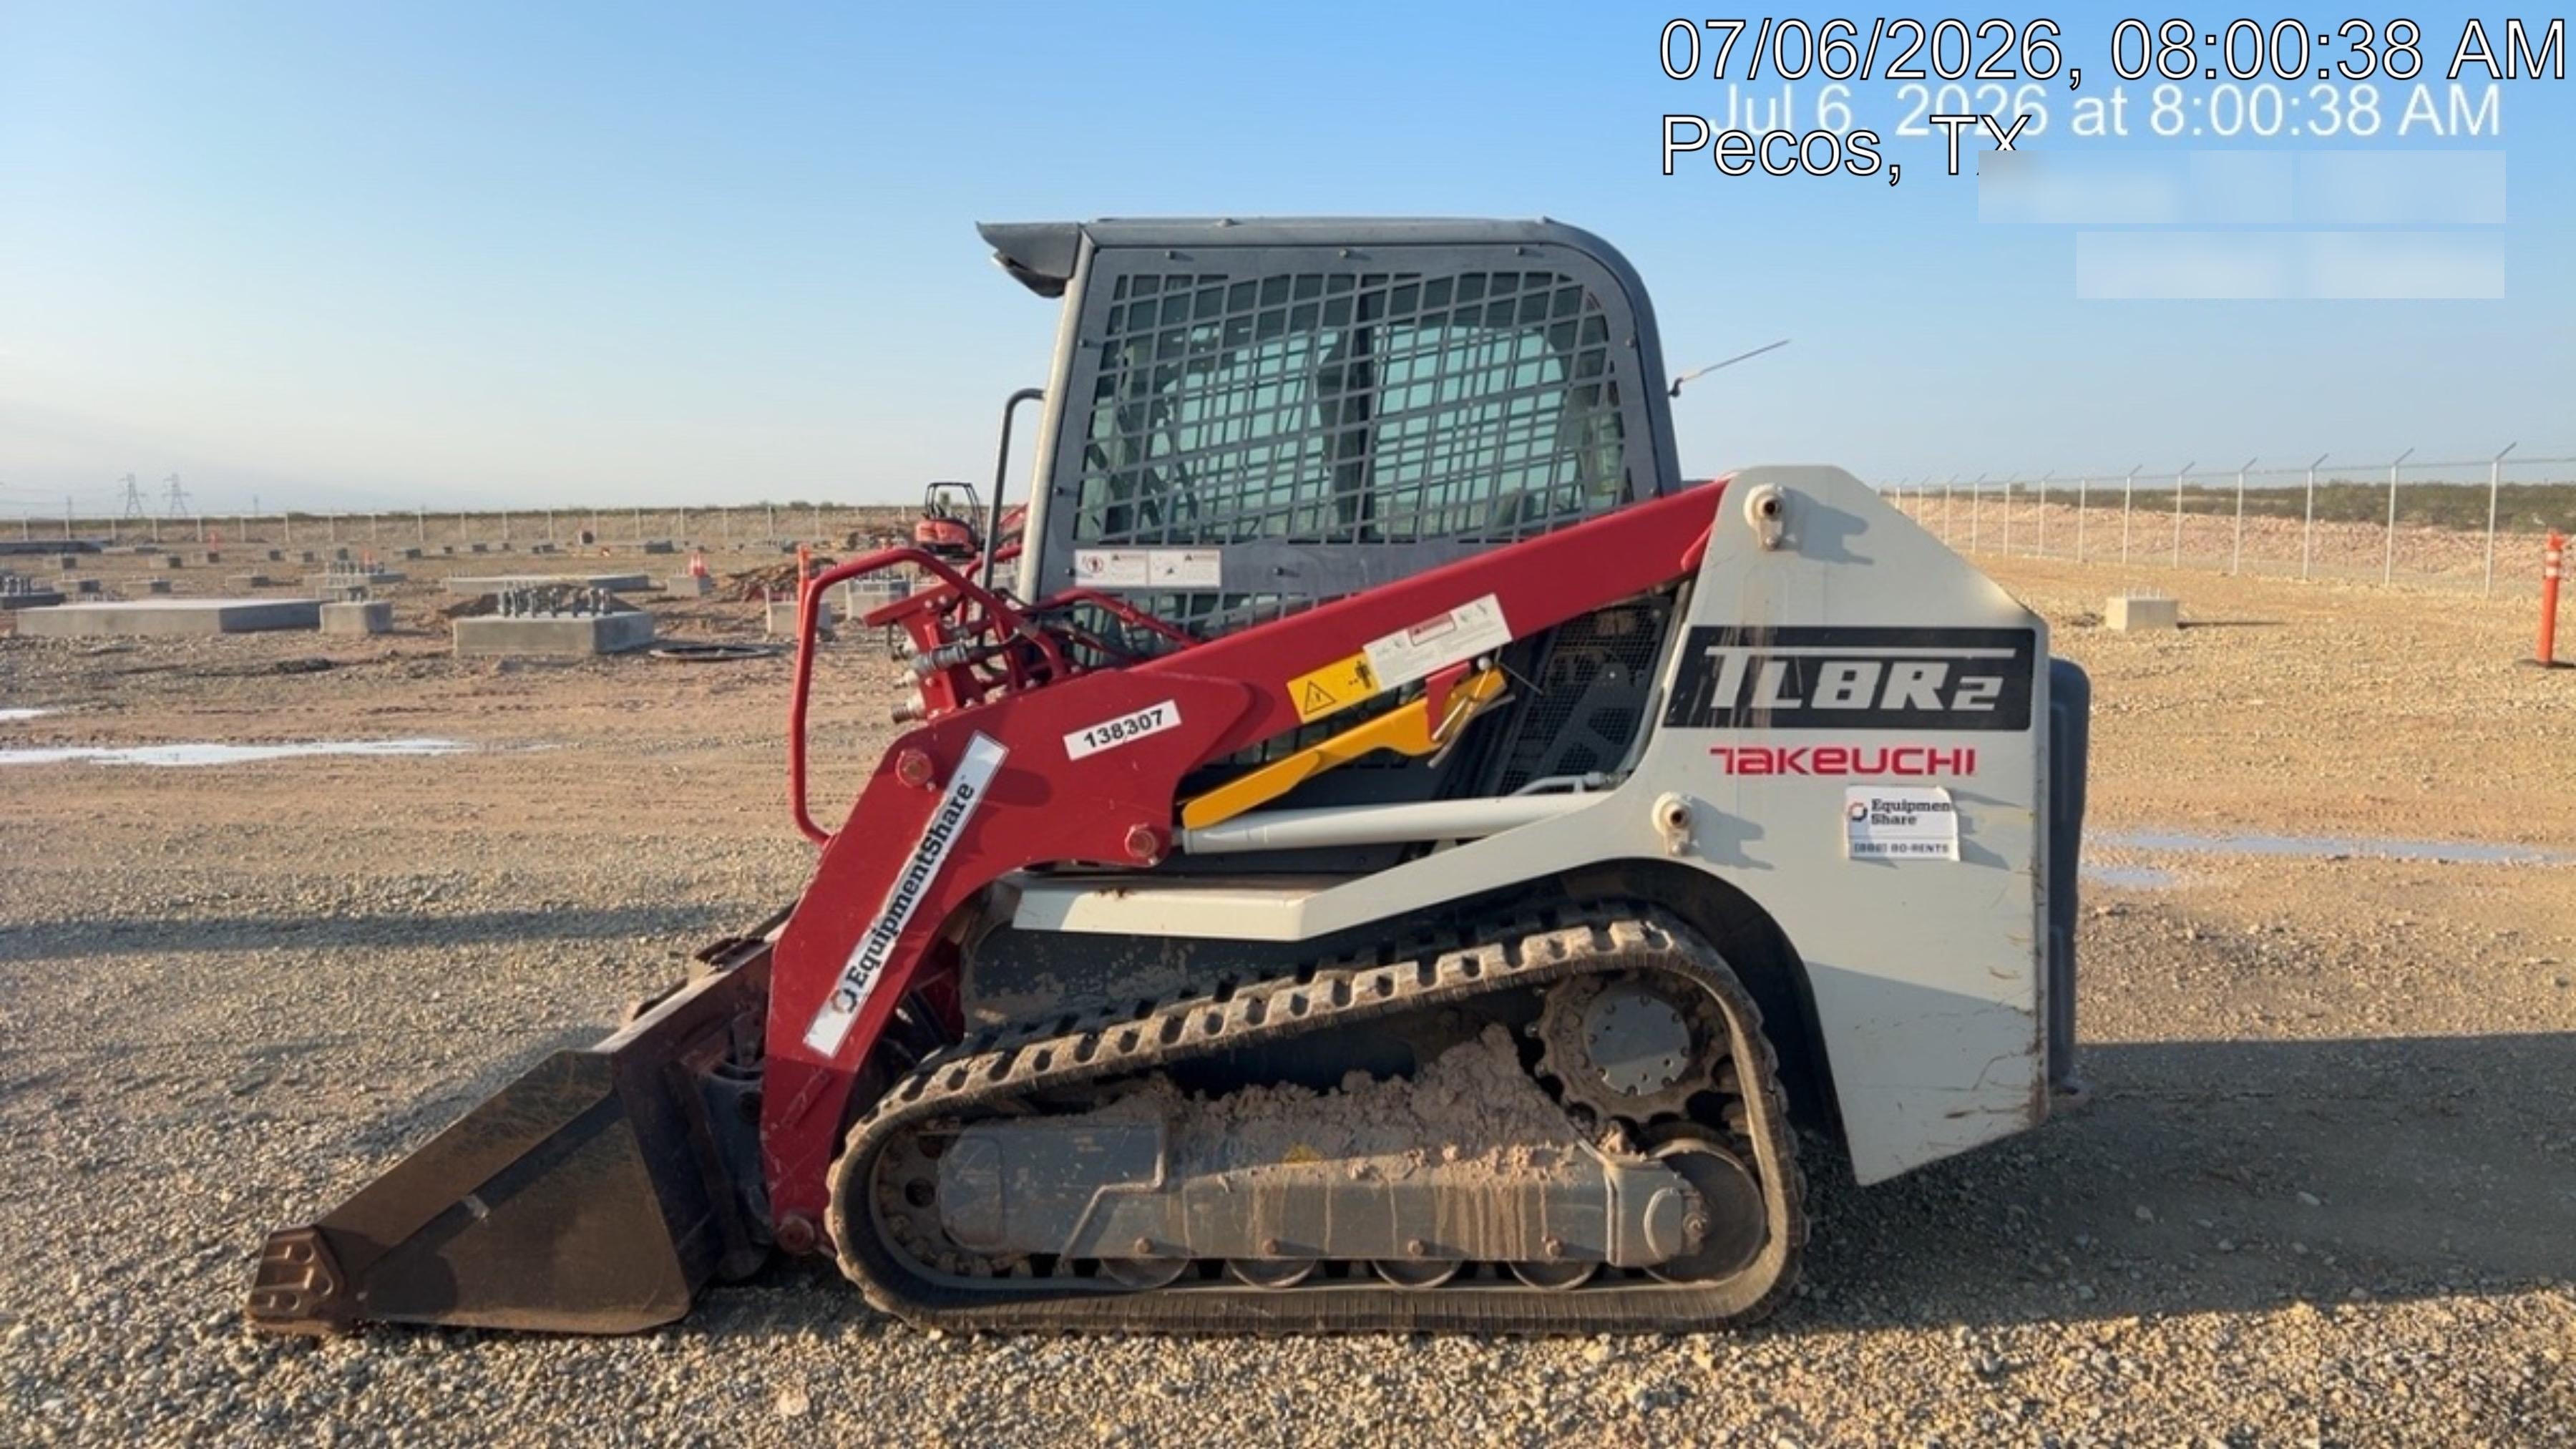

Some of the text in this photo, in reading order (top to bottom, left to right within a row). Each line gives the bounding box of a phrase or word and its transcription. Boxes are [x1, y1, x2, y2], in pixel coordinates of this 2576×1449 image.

[1084, 709, 1163, 747] 138307
[1871, 798, 1951, 814] Equipmen
[1871, 814, 1918, 825] Share
[846, 782, 975, 989] EquipmentShare
